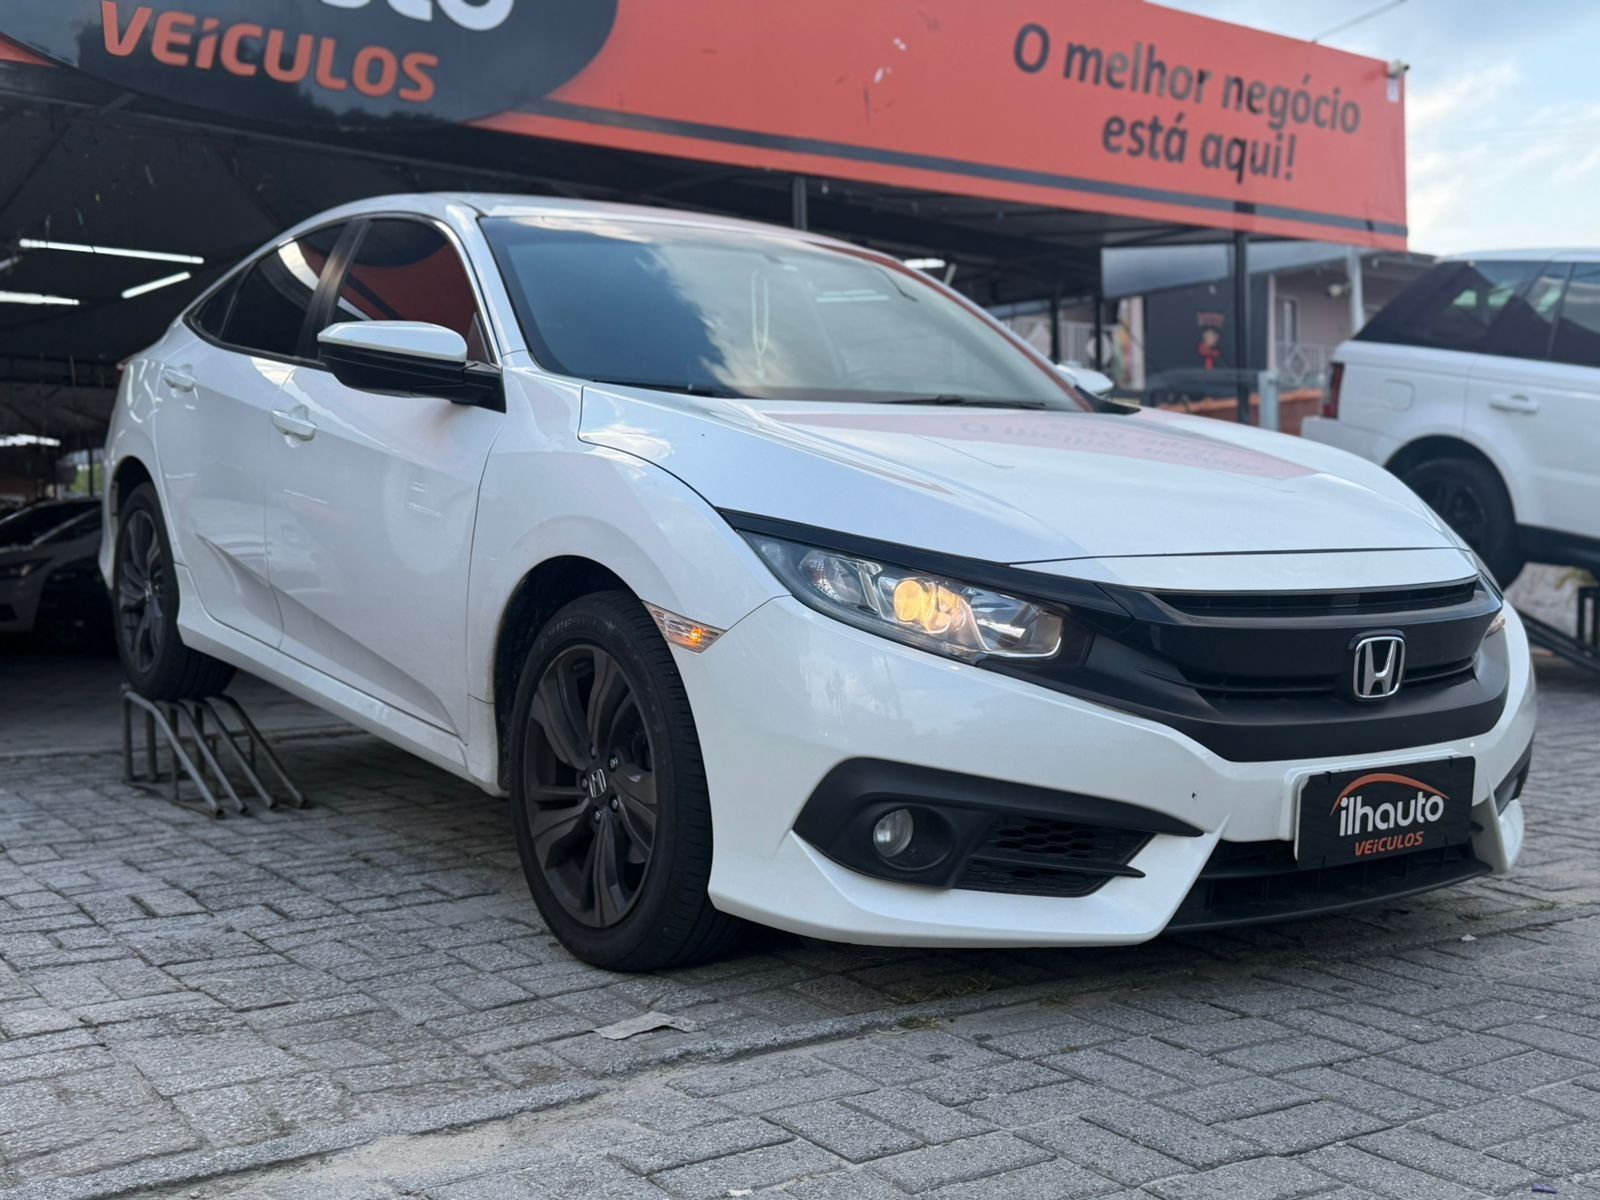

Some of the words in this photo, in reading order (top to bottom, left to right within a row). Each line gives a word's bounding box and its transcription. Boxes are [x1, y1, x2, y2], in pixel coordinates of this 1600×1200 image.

[1013, 22, 1051, 74] O
[1063, 41, 1212, 104] melhor
[1221, 73, 1361, 135] negócio
[1102, 112, 1187, 164] está
[1200, 131, 1297, 184] aqui!
[1339, 792, 1444, 837] ilhauto
